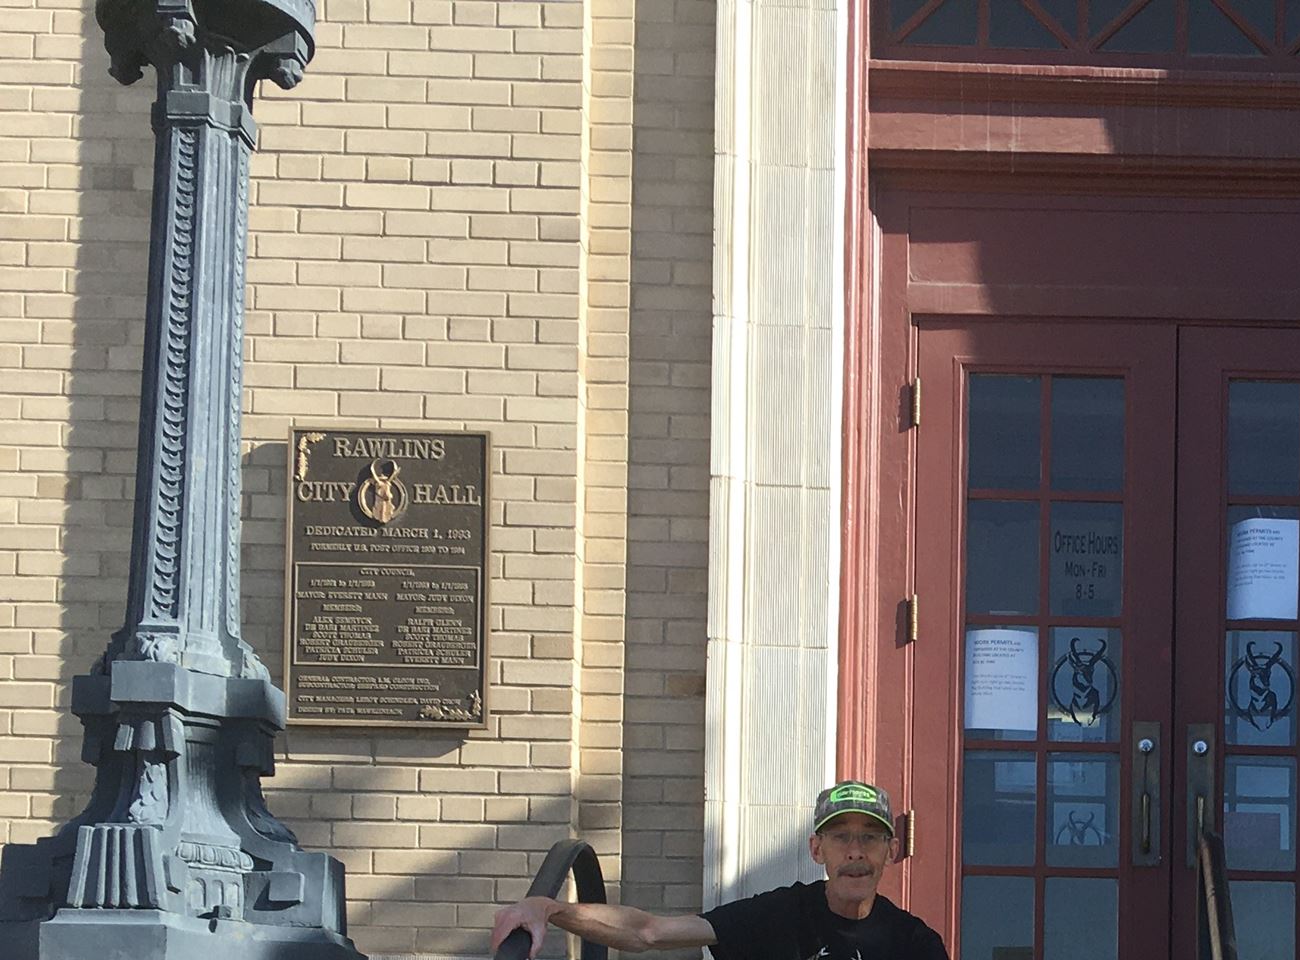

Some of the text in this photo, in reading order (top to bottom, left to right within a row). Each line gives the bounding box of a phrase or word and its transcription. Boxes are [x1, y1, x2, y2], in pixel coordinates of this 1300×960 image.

[333, 437, 446, 460] RAWLINS
[297, 481, 481, 507] CITY HALL
[305, 525, 378, 538] DEDICATED
[382, 526, 429, 539] MARCH
[1055, 530, 1118, 554] OFFICE HOURS
